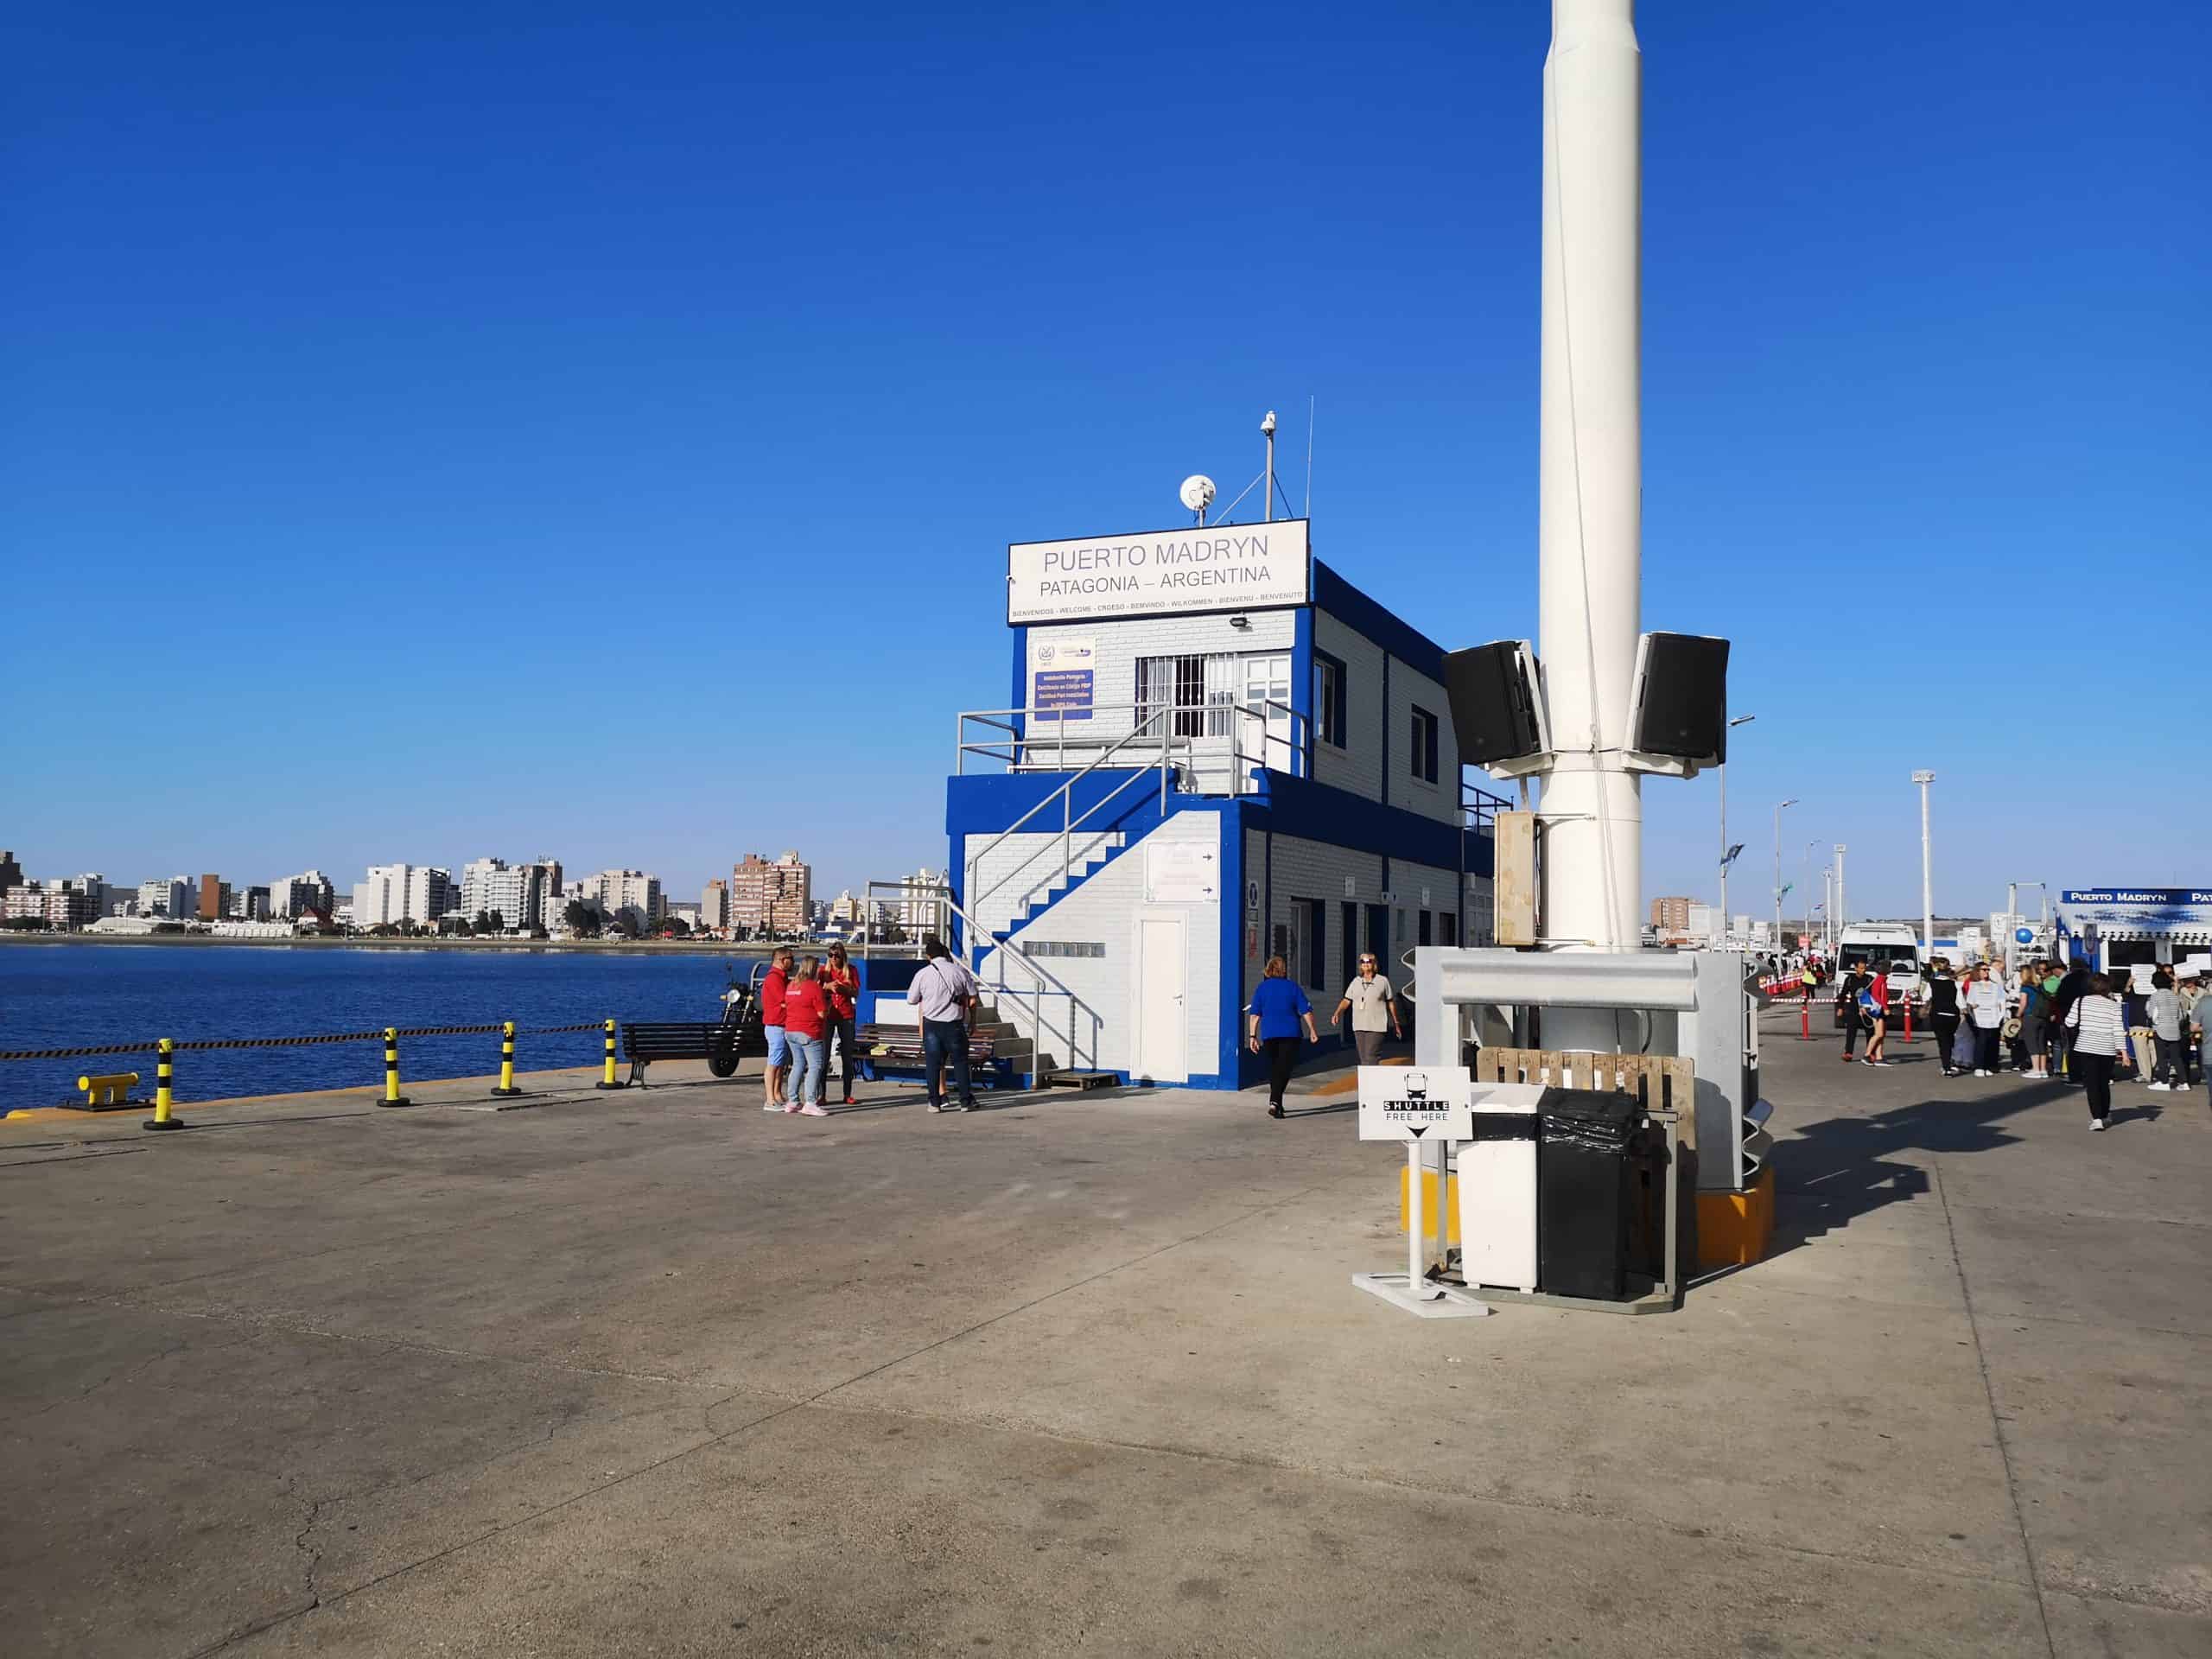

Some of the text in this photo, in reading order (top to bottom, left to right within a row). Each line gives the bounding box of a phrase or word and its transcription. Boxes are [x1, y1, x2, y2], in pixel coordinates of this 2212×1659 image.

[1044, 536, 1268, 573] PUERTO MADRYN
[1040, 575, 1140, 597] PATAGONIA
[1160, 566, 1272, 588] ARGENTINA
[1013, 608, 1054, 617] BIENVENIDOS
[1260, 592, 1303, 601] BENVENUTO
[2071, 893, 2113, 901] PUERTO
[2117, 893, 2167, 901] MADRYN
[1384, 1102, 1449, 1110] SHUTTLE
